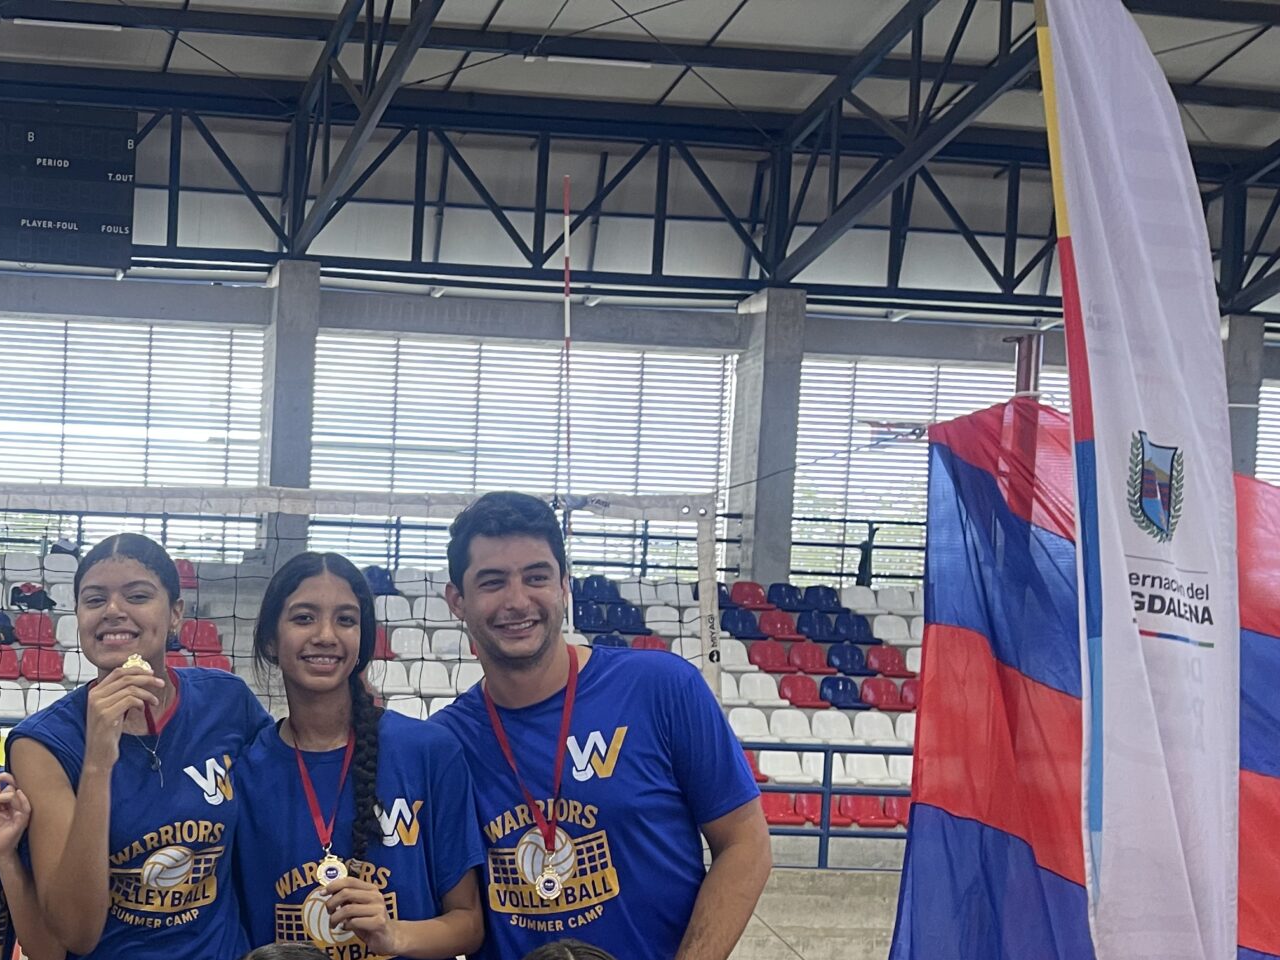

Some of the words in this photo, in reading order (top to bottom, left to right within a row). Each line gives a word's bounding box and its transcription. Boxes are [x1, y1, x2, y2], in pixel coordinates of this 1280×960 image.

[36, 157, 70, 168] PERIOD
[107, 172, 134, 182] T.OUT
[20, 218, 79, 231] PLAYER-FOUL
[101, 224, 130, 234] FOULS
[1186, 582, 1210, 601] del
[1131, 590, 1214, 626] GDALENA
[109, 819, 225, 865] WARRIORS
[111, 905, 162, 929] SUMMER
[165, 908, 200, 927] CAMP
[509, 913, 564, 932] SUMMER
[568, 904, 605, 928] CAMP
